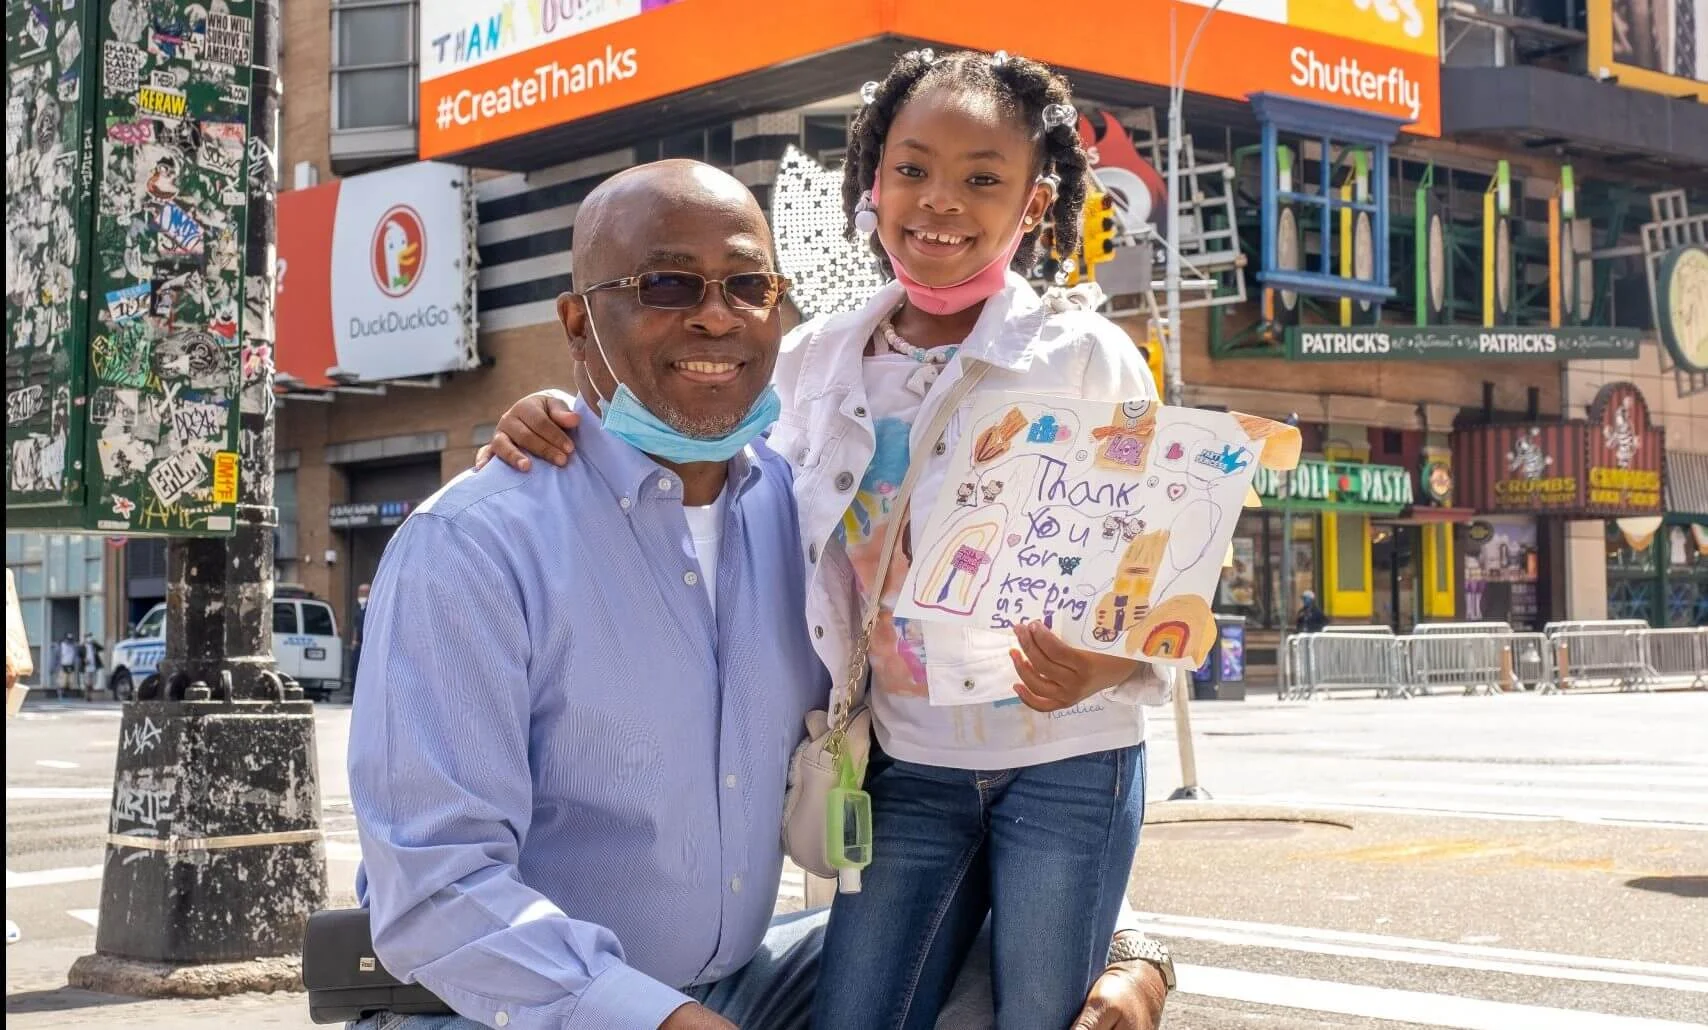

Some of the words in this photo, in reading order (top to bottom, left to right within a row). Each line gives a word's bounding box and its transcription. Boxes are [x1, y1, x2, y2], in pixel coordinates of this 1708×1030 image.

[208, 13, 228, 29] WHO
[231, 16, 251, 32] WILL
[207, 30, 240, 48] SURVIVE
[208, 46, 249, 64] AMERICA?
[436, 45, 638, 129] #CreateThanks
[1290, 46, 1421, 120] Shutterfly
[141, 88, 186, 116] KERAW
[350, 305, 449, 339] DuckDuckGo
[1302, 333, 1390, 353] PATRICK'S
[1480, 333, 1557, 353] PATRICK'S
[1038, 454, 1139, 508] Thank
[1360, 467, 1414, 504] PASTA
[1025, 507, 1090, 548] You
[996, 598, 1024, 614] us
